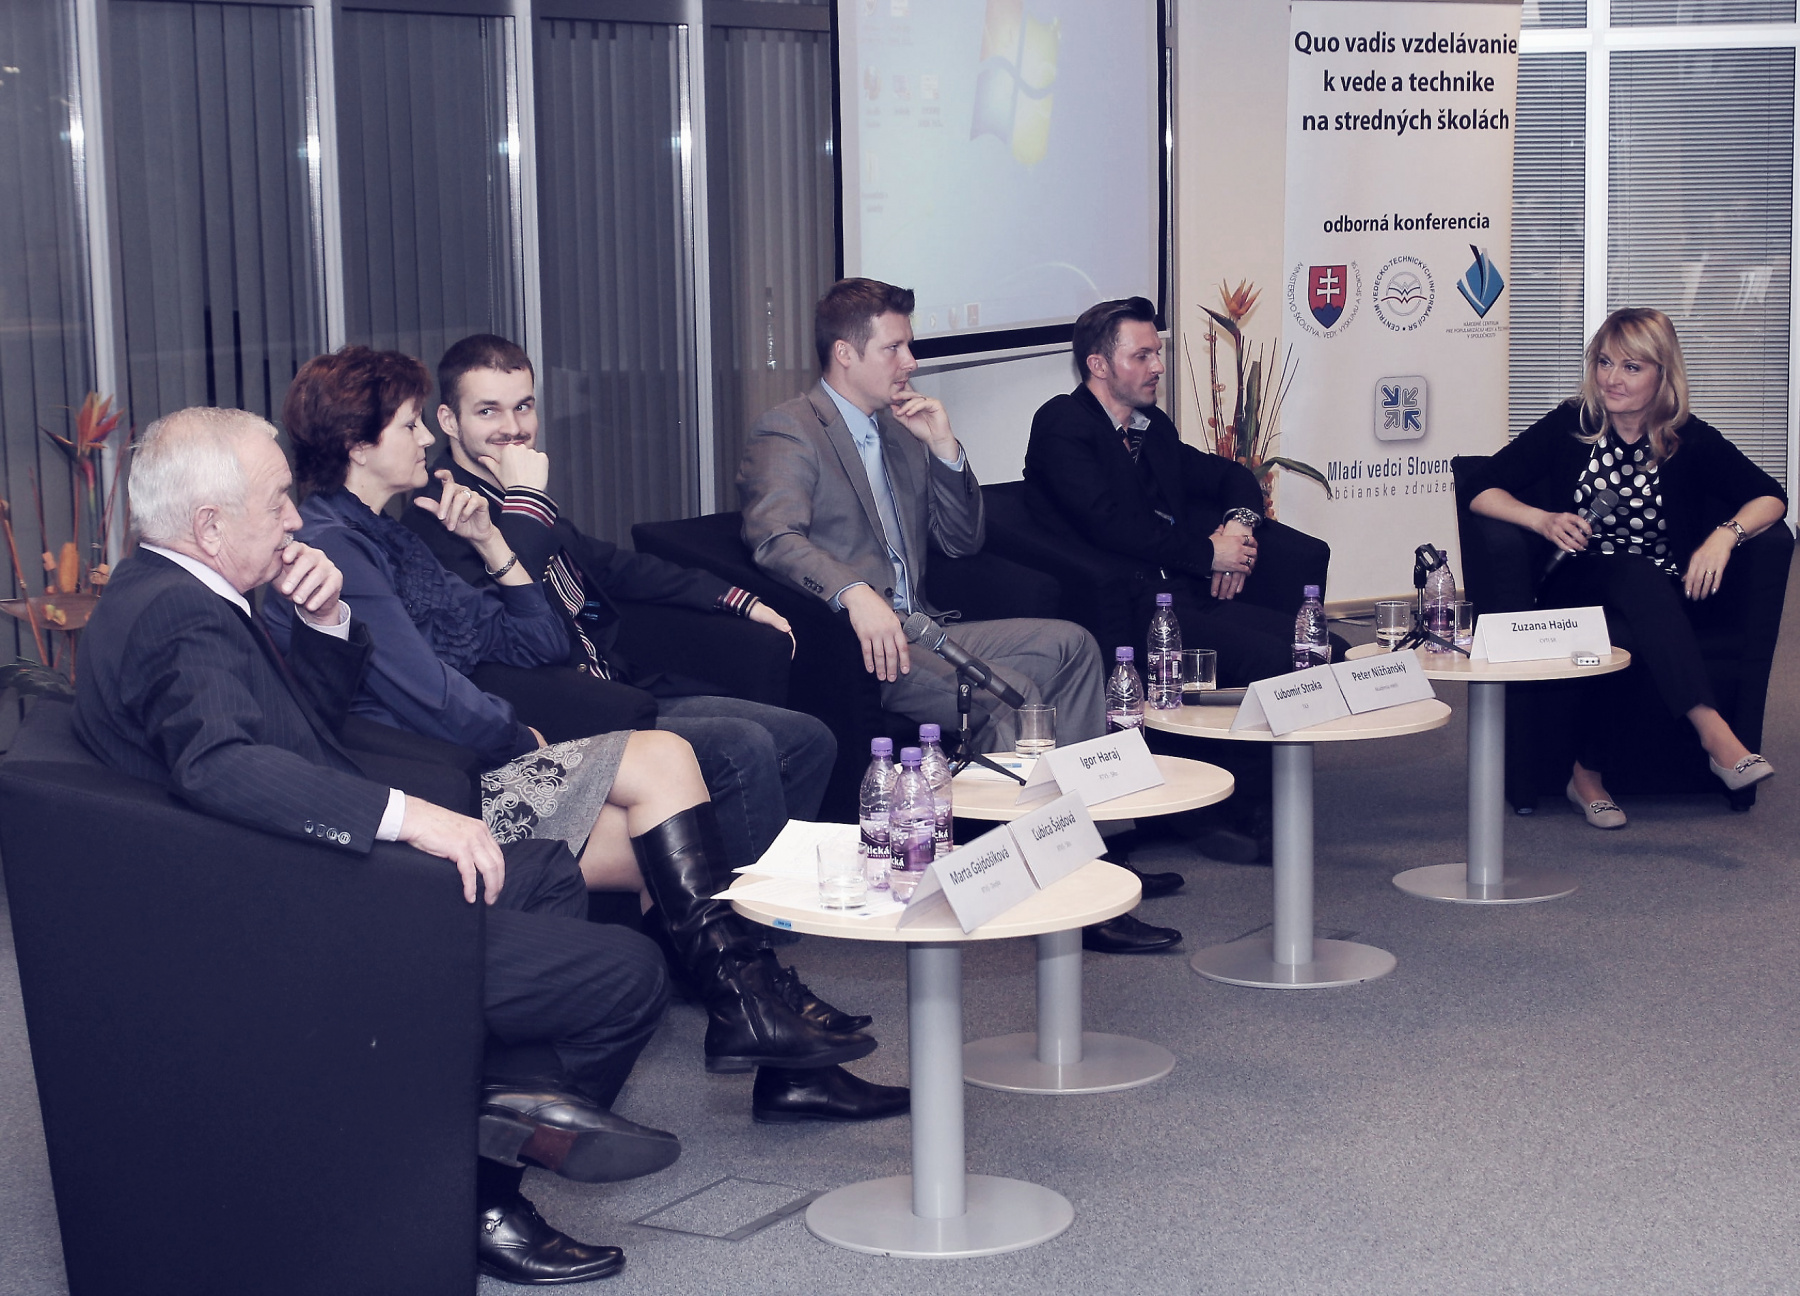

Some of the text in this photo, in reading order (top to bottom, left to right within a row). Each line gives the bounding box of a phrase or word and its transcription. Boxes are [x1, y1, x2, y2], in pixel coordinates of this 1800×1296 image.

[1294, 31, 1517, 55] Quo vadis vzdelávanie
[1323, 70, 1495, 92] k vede a technike
[1302, 109, 1509, 136] na stredných školách
[1323, 213, 1490, 232] odborná konferencia
[1373, 303, 1401, 332] CENTRUM
[1327, 460, 1362, 481] Mladí
[1367, 457, 1402, 479] vedci
[1511, 618, 1579, 632] Zuzana Hajdu
[1351, 661, 1407, 681] Peter Nižňanský
[1300, 679, 1323, 694] Straka
[1079, 746, 1122, 770] Igor Haraj
[1049, 810, 1077, 833] Šajdová
[949, 867, 973, 886] Marta
